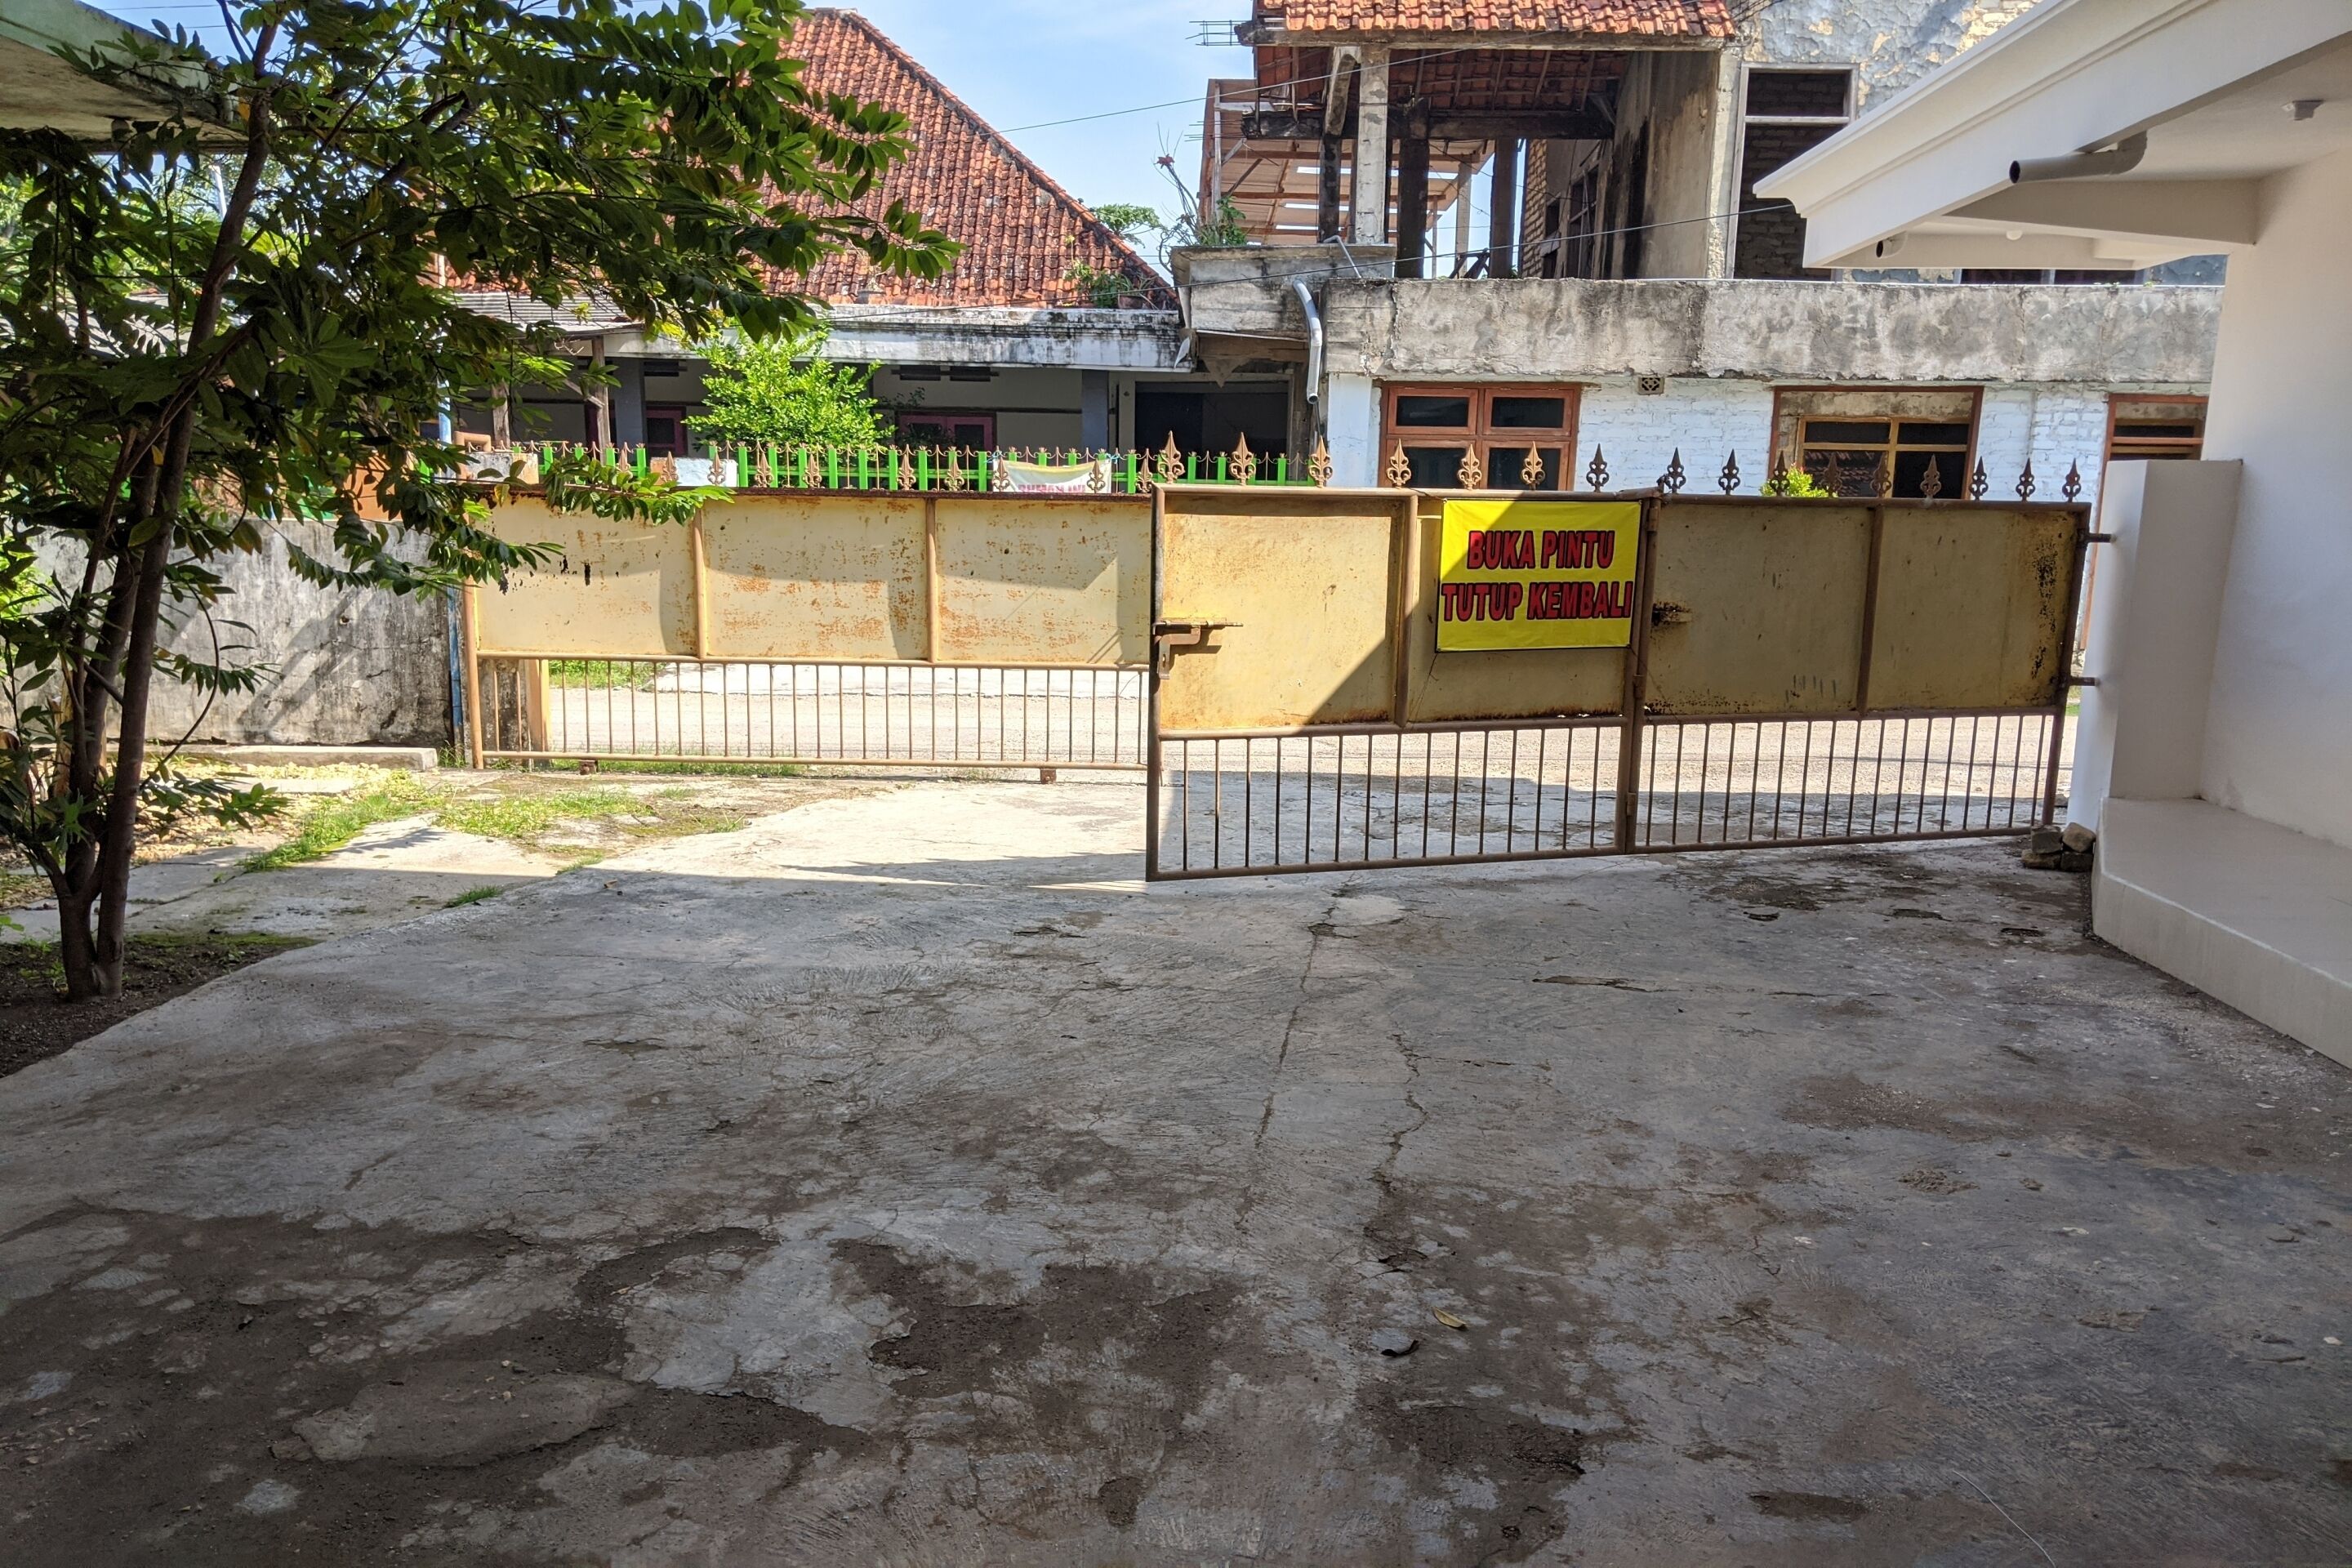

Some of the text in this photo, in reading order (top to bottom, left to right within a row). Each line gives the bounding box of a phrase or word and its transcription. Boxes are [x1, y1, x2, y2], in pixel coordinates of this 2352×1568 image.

[1467, 530, 1615, 569] BUKA PINTU
[1441, 581, 1633, 621] TUTUP KEMBALI
